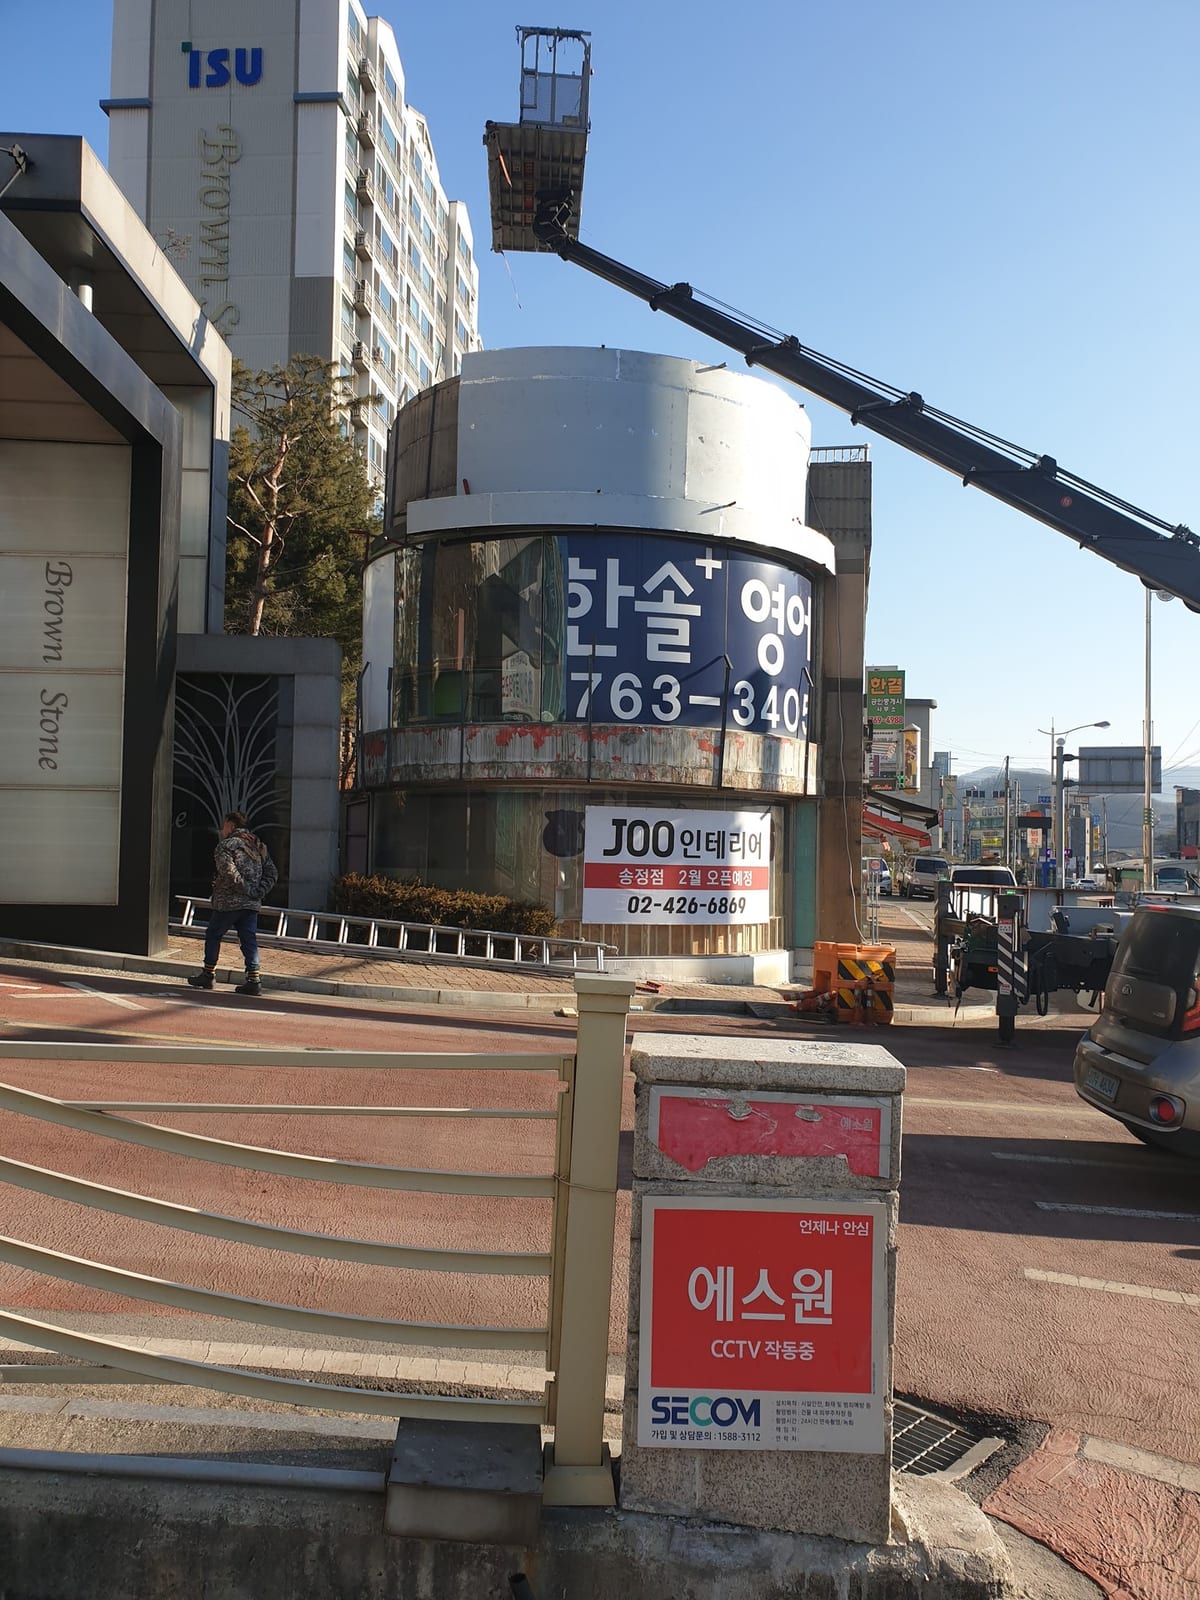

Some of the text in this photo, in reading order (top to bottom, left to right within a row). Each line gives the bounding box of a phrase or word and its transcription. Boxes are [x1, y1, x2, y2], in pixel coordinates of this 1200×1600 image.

[188, 47, 263, 88] ISU
[199, 123, 242, 286] Brown
[38, 561, 73, 770] Brown Stone
[870, 677, 903, 695] 한결
[618, 867, 753, 887] 송정점 2월 오픈예정
[627, 896, 746, 915] 02-426-6869
[799, 1219, 870, 1237] 언제나 안심
[687, 1266, 833, 1325] 에스원
[651, 1396, 761, 1427] SECOM
[651, 1430, 668, 1440] 가입
[669, 1430, 676, 1440] 및
